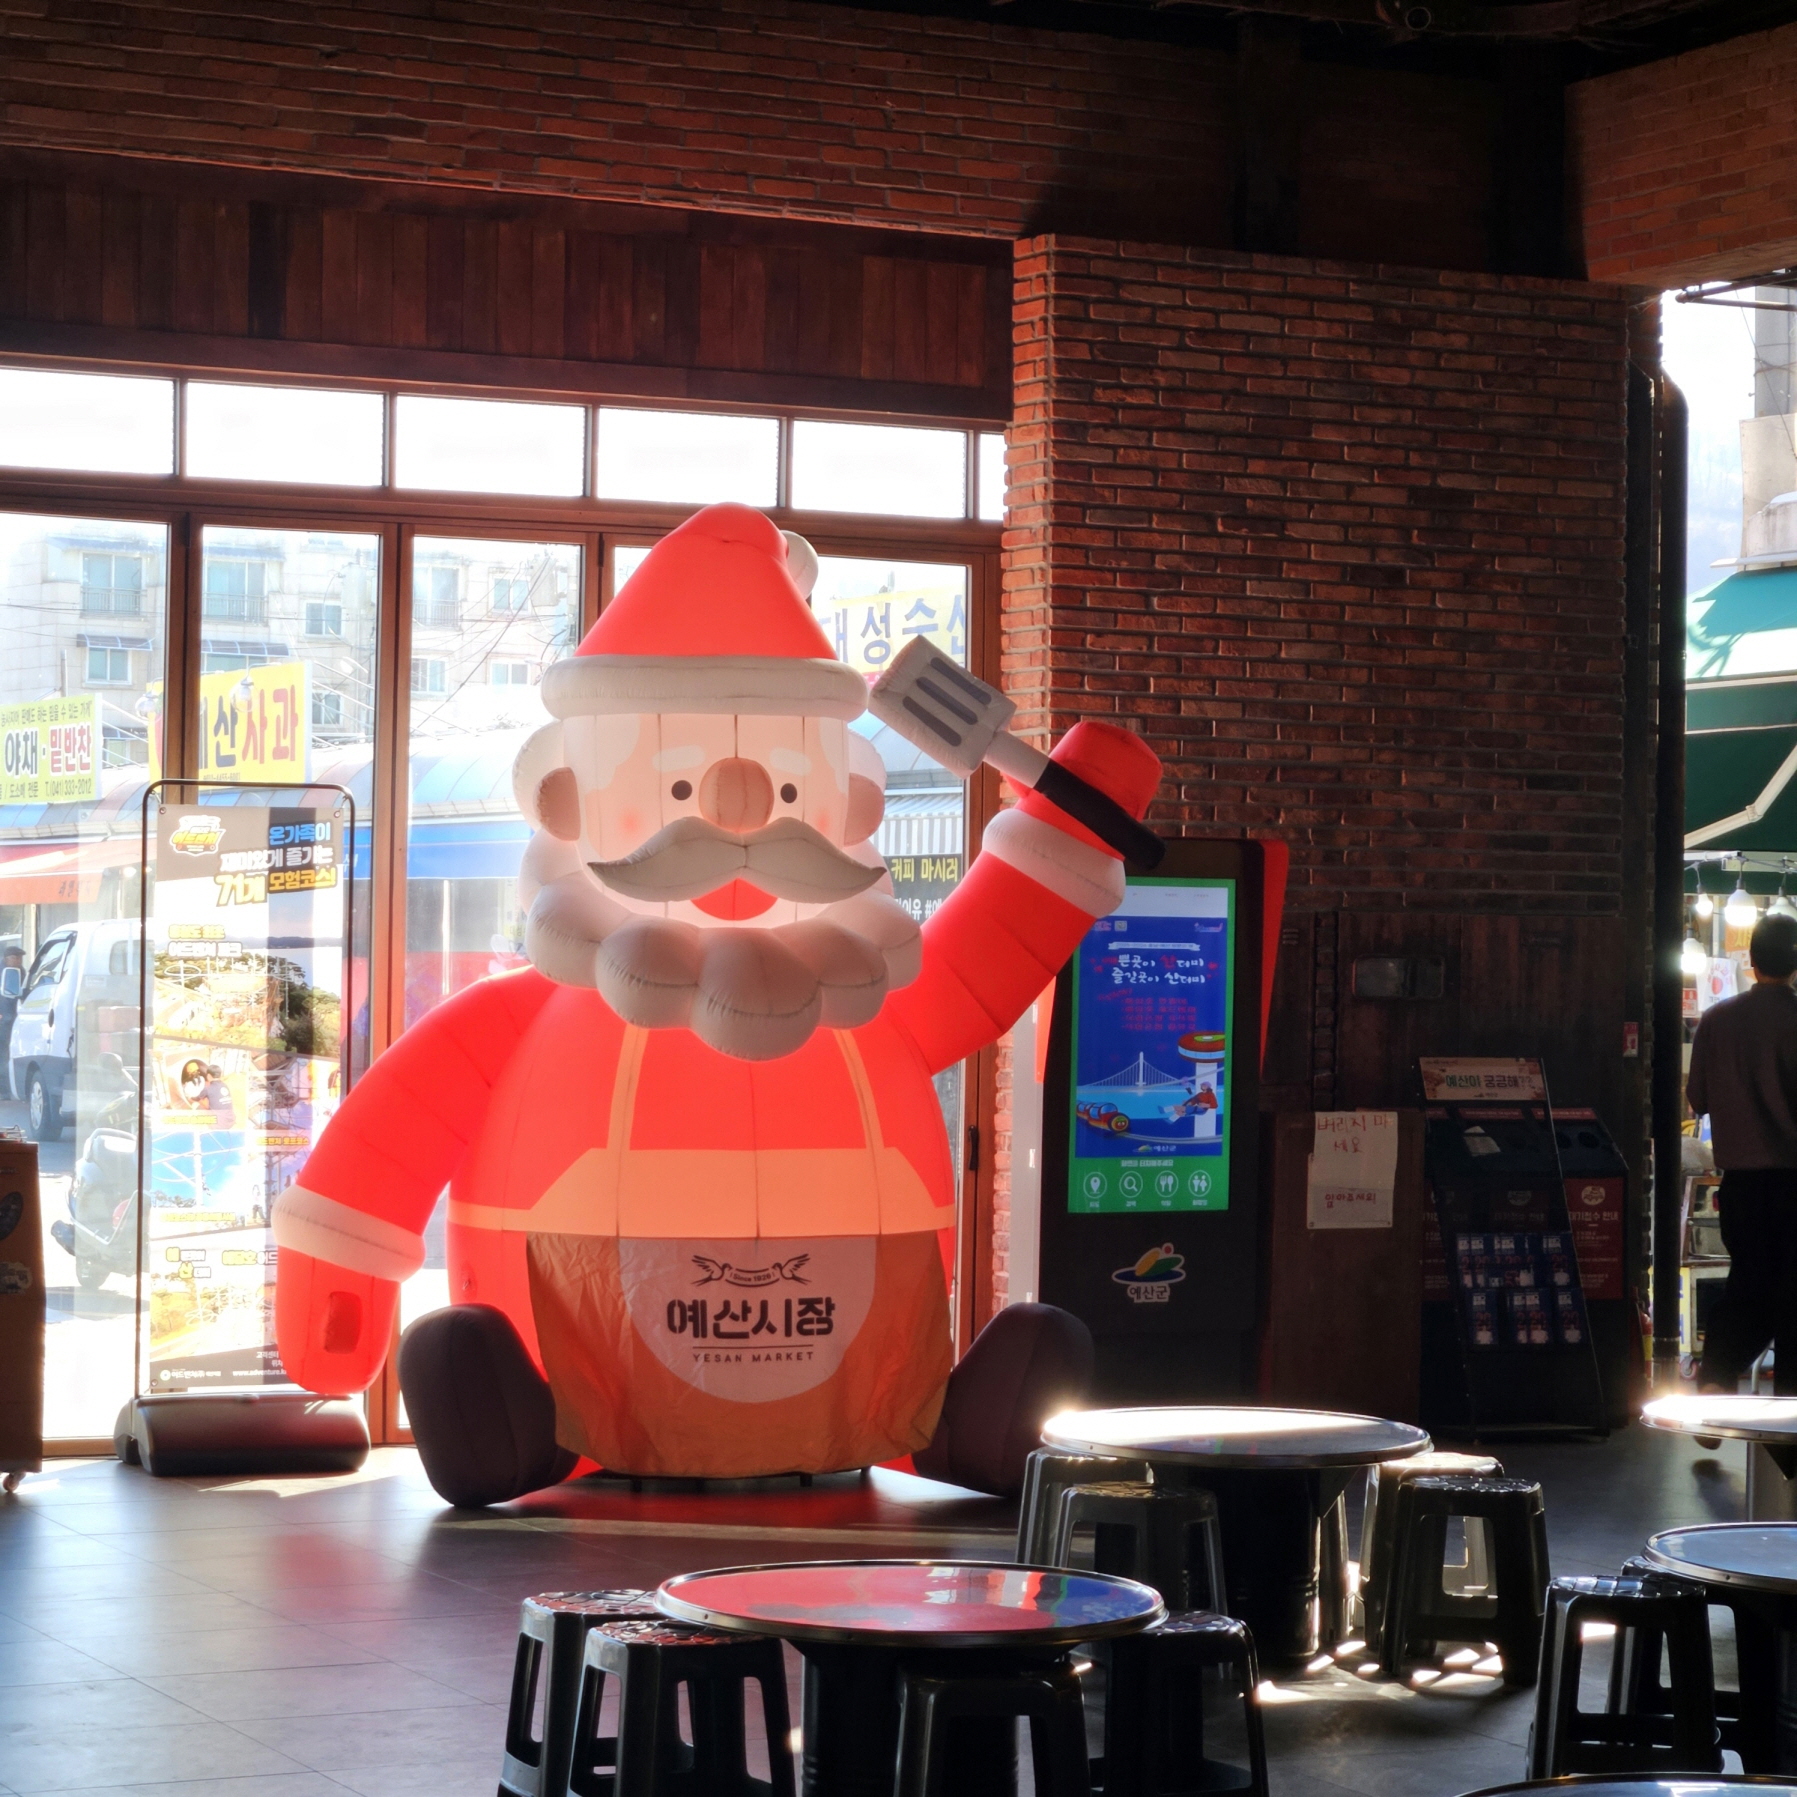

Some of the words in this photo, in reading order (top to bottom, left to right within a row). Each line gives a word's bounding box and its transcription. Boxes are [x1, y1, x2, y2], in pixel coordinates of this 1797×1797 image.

[269, 822, 331, 846] 온가족이
[286, 844, 334, 867] 즐기는
[890, 857, 915, 883] 커피
[920, 857, 959, 883] 마시러
[1164, 972, 1206, 985] 산더미
[1446, 1075, 1480, 1088] 예산이
[1317, 1115, 1366, 1132] 버리지
[733, 1274, 752, 1282] Since
[1130, 1285, 1168, 1300] 예산군
[667, 1297, 836, 1339] 예산시장
[693, 1353, 743, 1363] YESAN
[752, 1351, 814, 1363] MARKET
